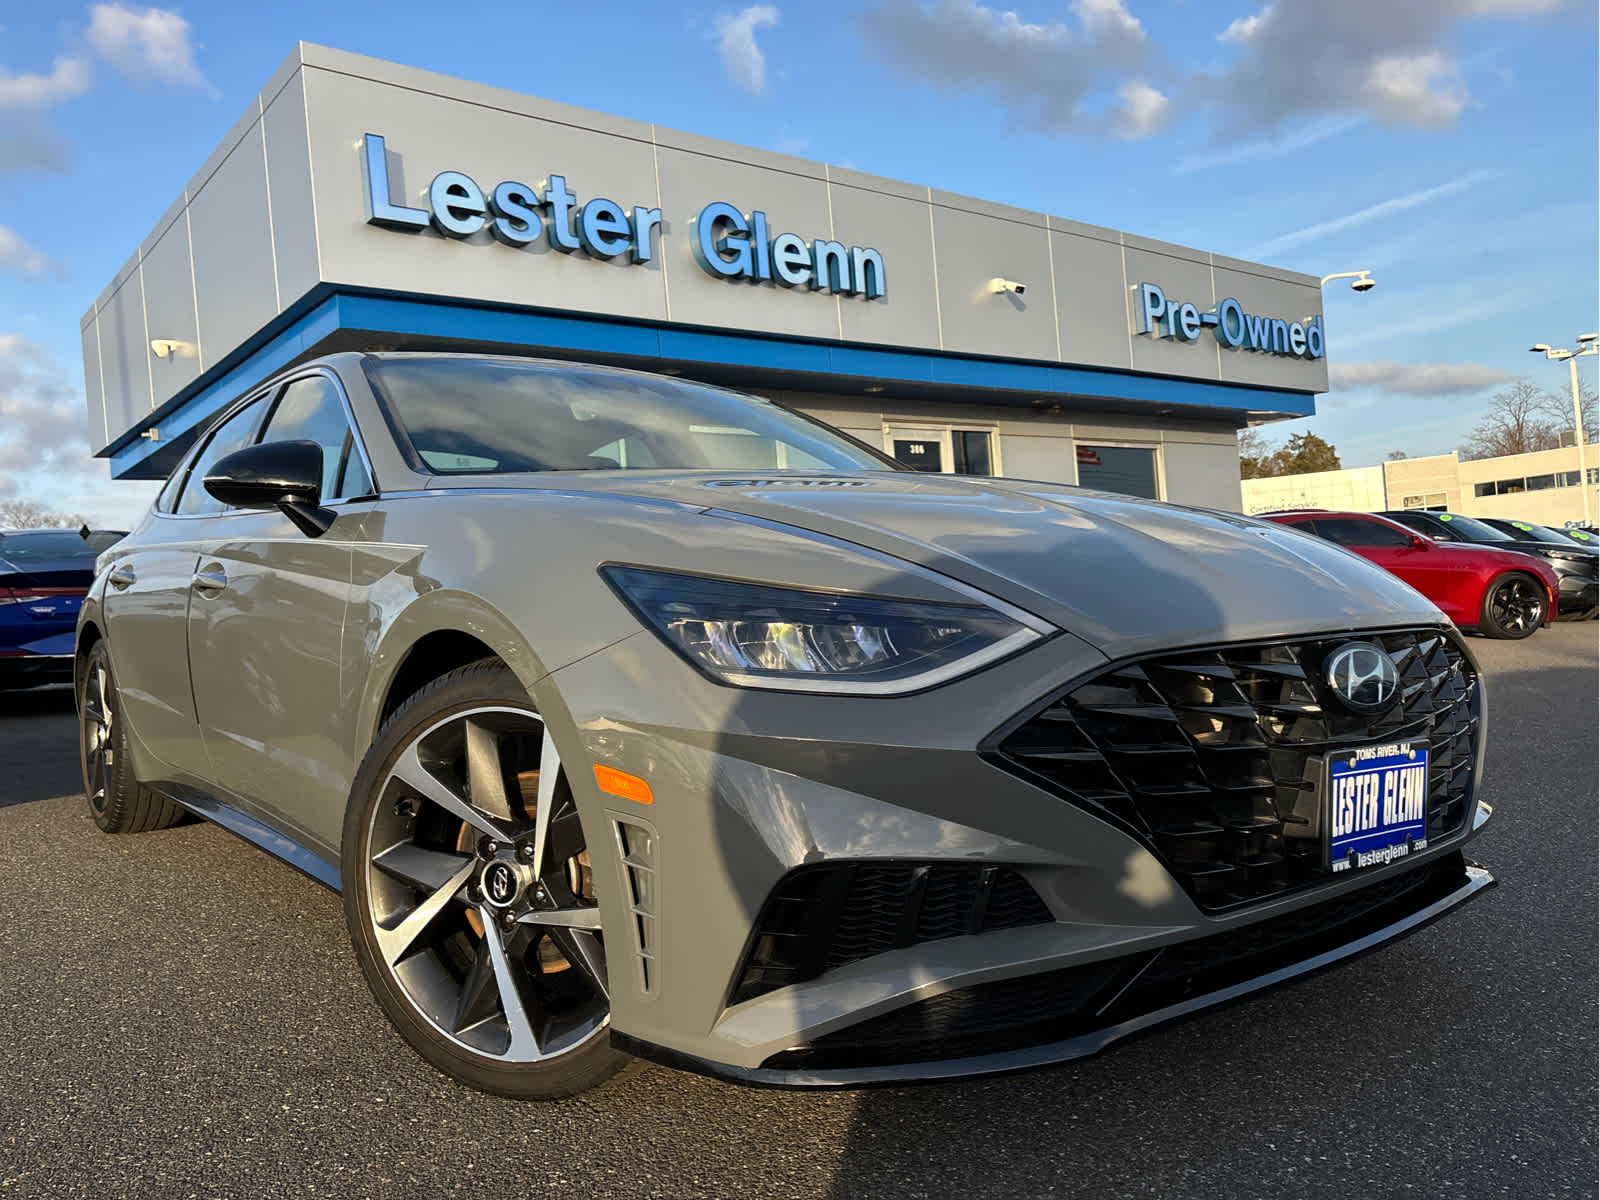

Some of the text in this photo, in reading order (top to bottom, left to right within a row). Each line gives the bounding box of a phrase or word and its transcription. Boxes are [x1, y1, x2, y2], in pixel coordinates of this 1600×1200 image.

[360, 132, 887, 299] Lester Glenn
[1134, 282, 1325, 360] Pre-Owned
[1355, 747, 1377, 760] TOMS
[1400, 743, 1410, 755] NJ
[1332, 766, 1425, 837] LESTER GLENN
[1358, 844, 1408, 868] lesterglenn
[1413, 839, 1427, 851] .com
